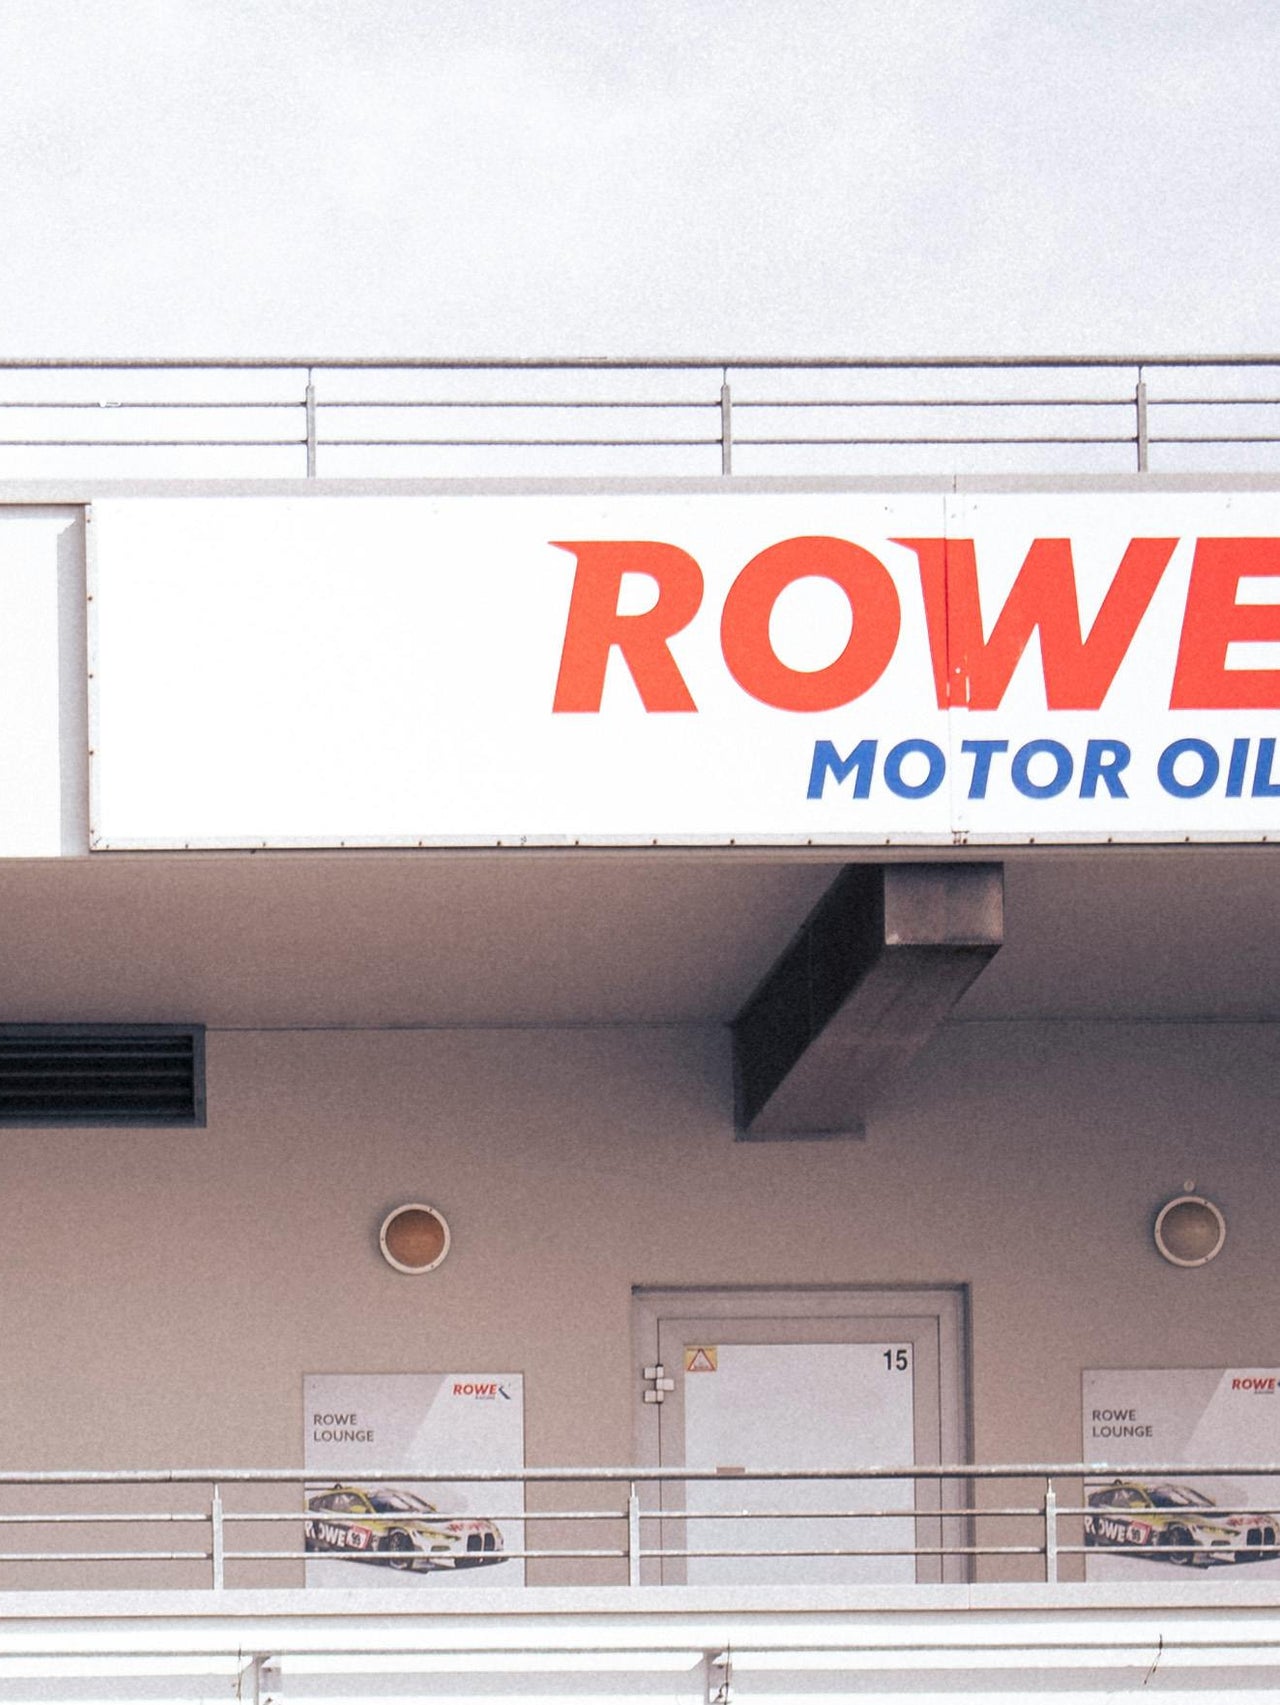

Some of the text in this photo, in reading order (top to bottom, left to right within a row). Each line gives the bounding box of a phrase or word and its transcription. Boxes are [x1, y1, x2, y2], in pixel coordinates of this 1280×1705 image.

[547, 535, 1280, 714] ROWE
[806, 738, 1131, 800] MOTOR
[883, 1349, 908, 1371] 15
[453, 1383, 498, 1396] ROWE
[1232, 1378, 1276, 1391] ROWE
[313, 1414, 357, 1426] ROWE
[1092, 1409, 1137, 1422] ROWE
[313, 1430, 374, 1442] LOUNGE
[1092, 1425, 1153, 1438] LOUNGE
